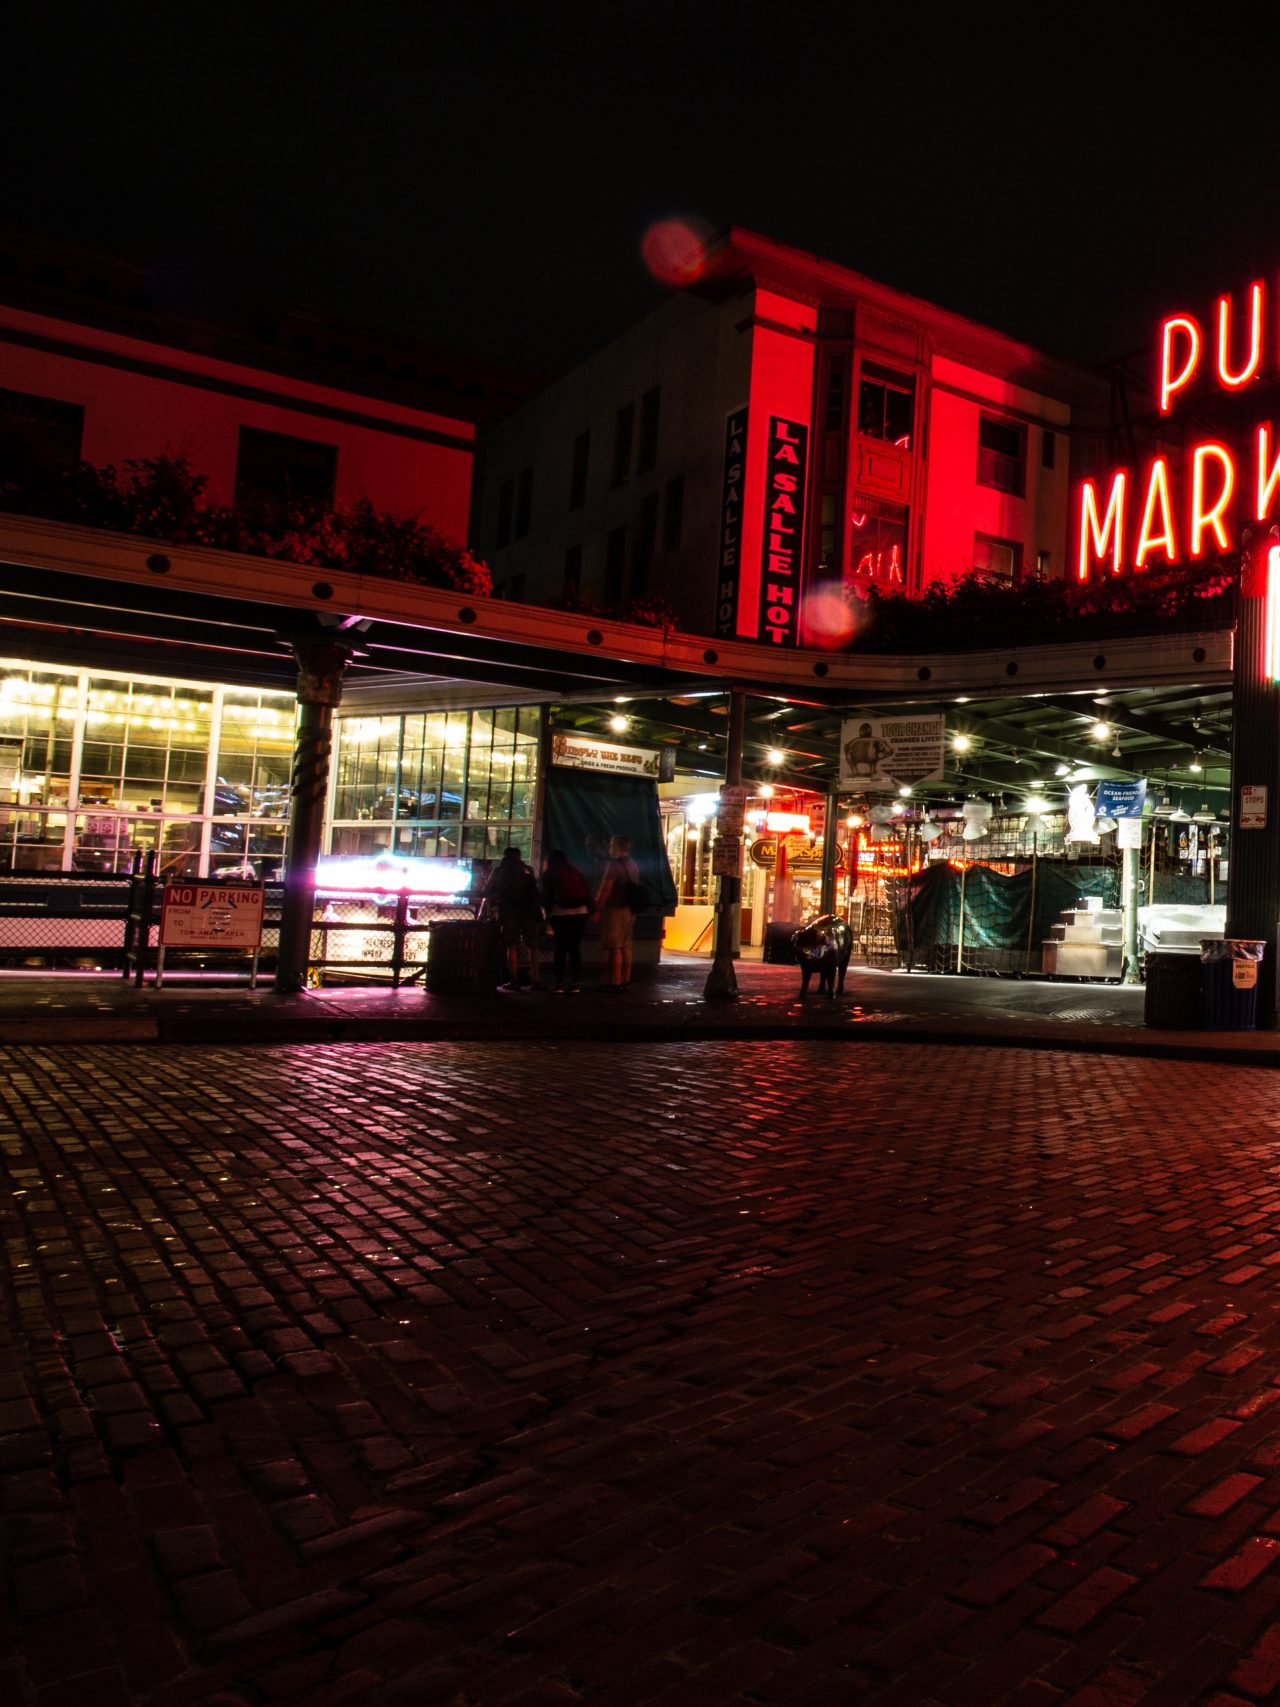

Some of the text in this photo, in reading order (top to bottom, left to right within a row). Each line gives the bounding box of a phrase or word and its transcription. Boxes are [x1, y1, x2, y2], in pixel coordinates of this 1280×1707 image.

[765, 421, 799, 644] LA SALLE HOT
[881, 721, 942, 738] YOUR CHANGE
[616, 763, 637, 772] PRODUCE
[1244, 796, 1264, 804] STOPS
[170, 889, 259, 905] NO PARKING
